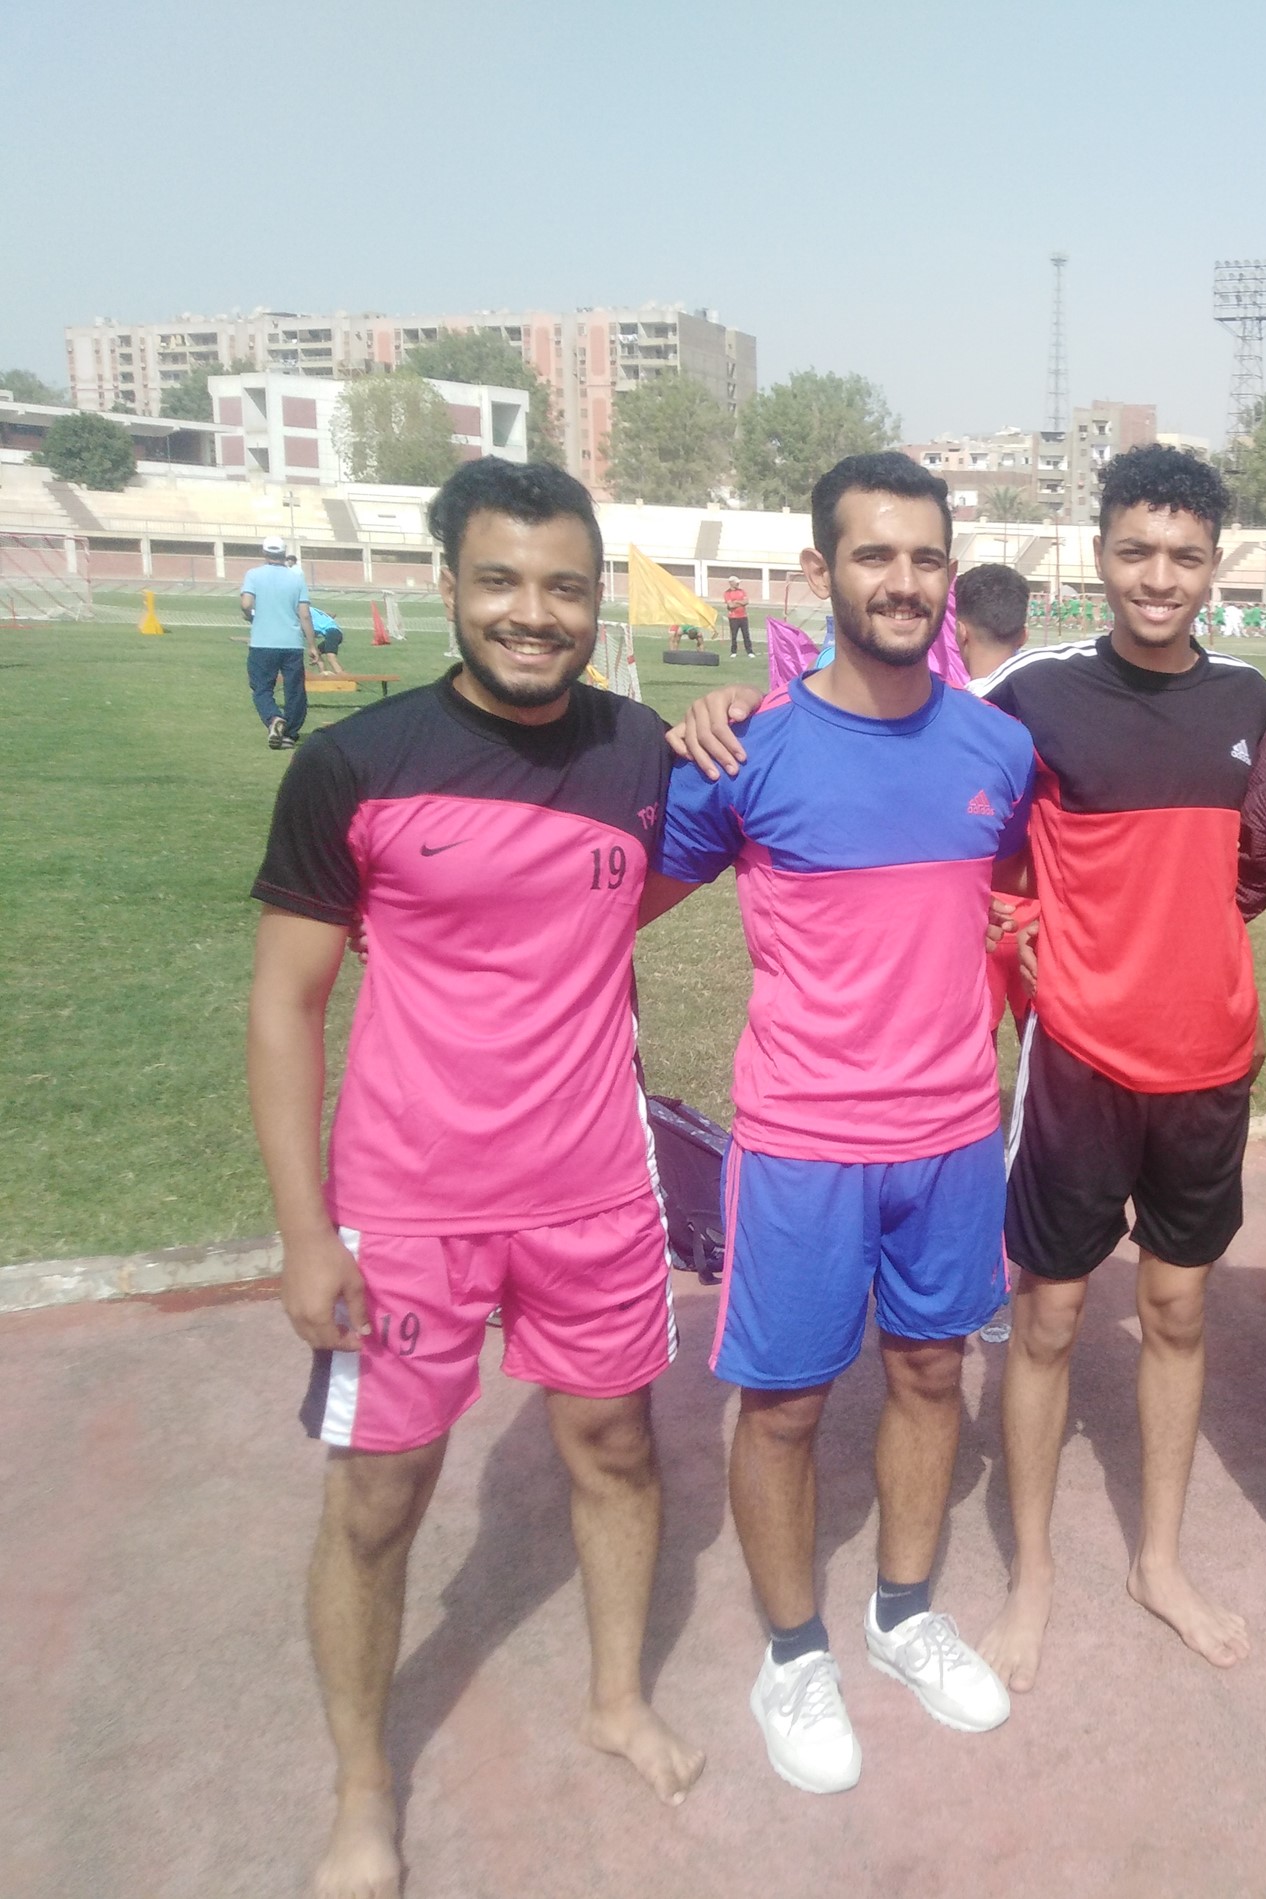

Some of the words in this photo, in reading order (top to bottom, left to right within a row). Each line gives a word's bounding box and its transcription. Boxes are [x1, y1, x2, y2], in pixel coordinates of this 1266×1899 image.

[637, 801, 659, 830] T9
[590, 845, 626, 890] 19
[379, 1312, 420, 1356] 19
